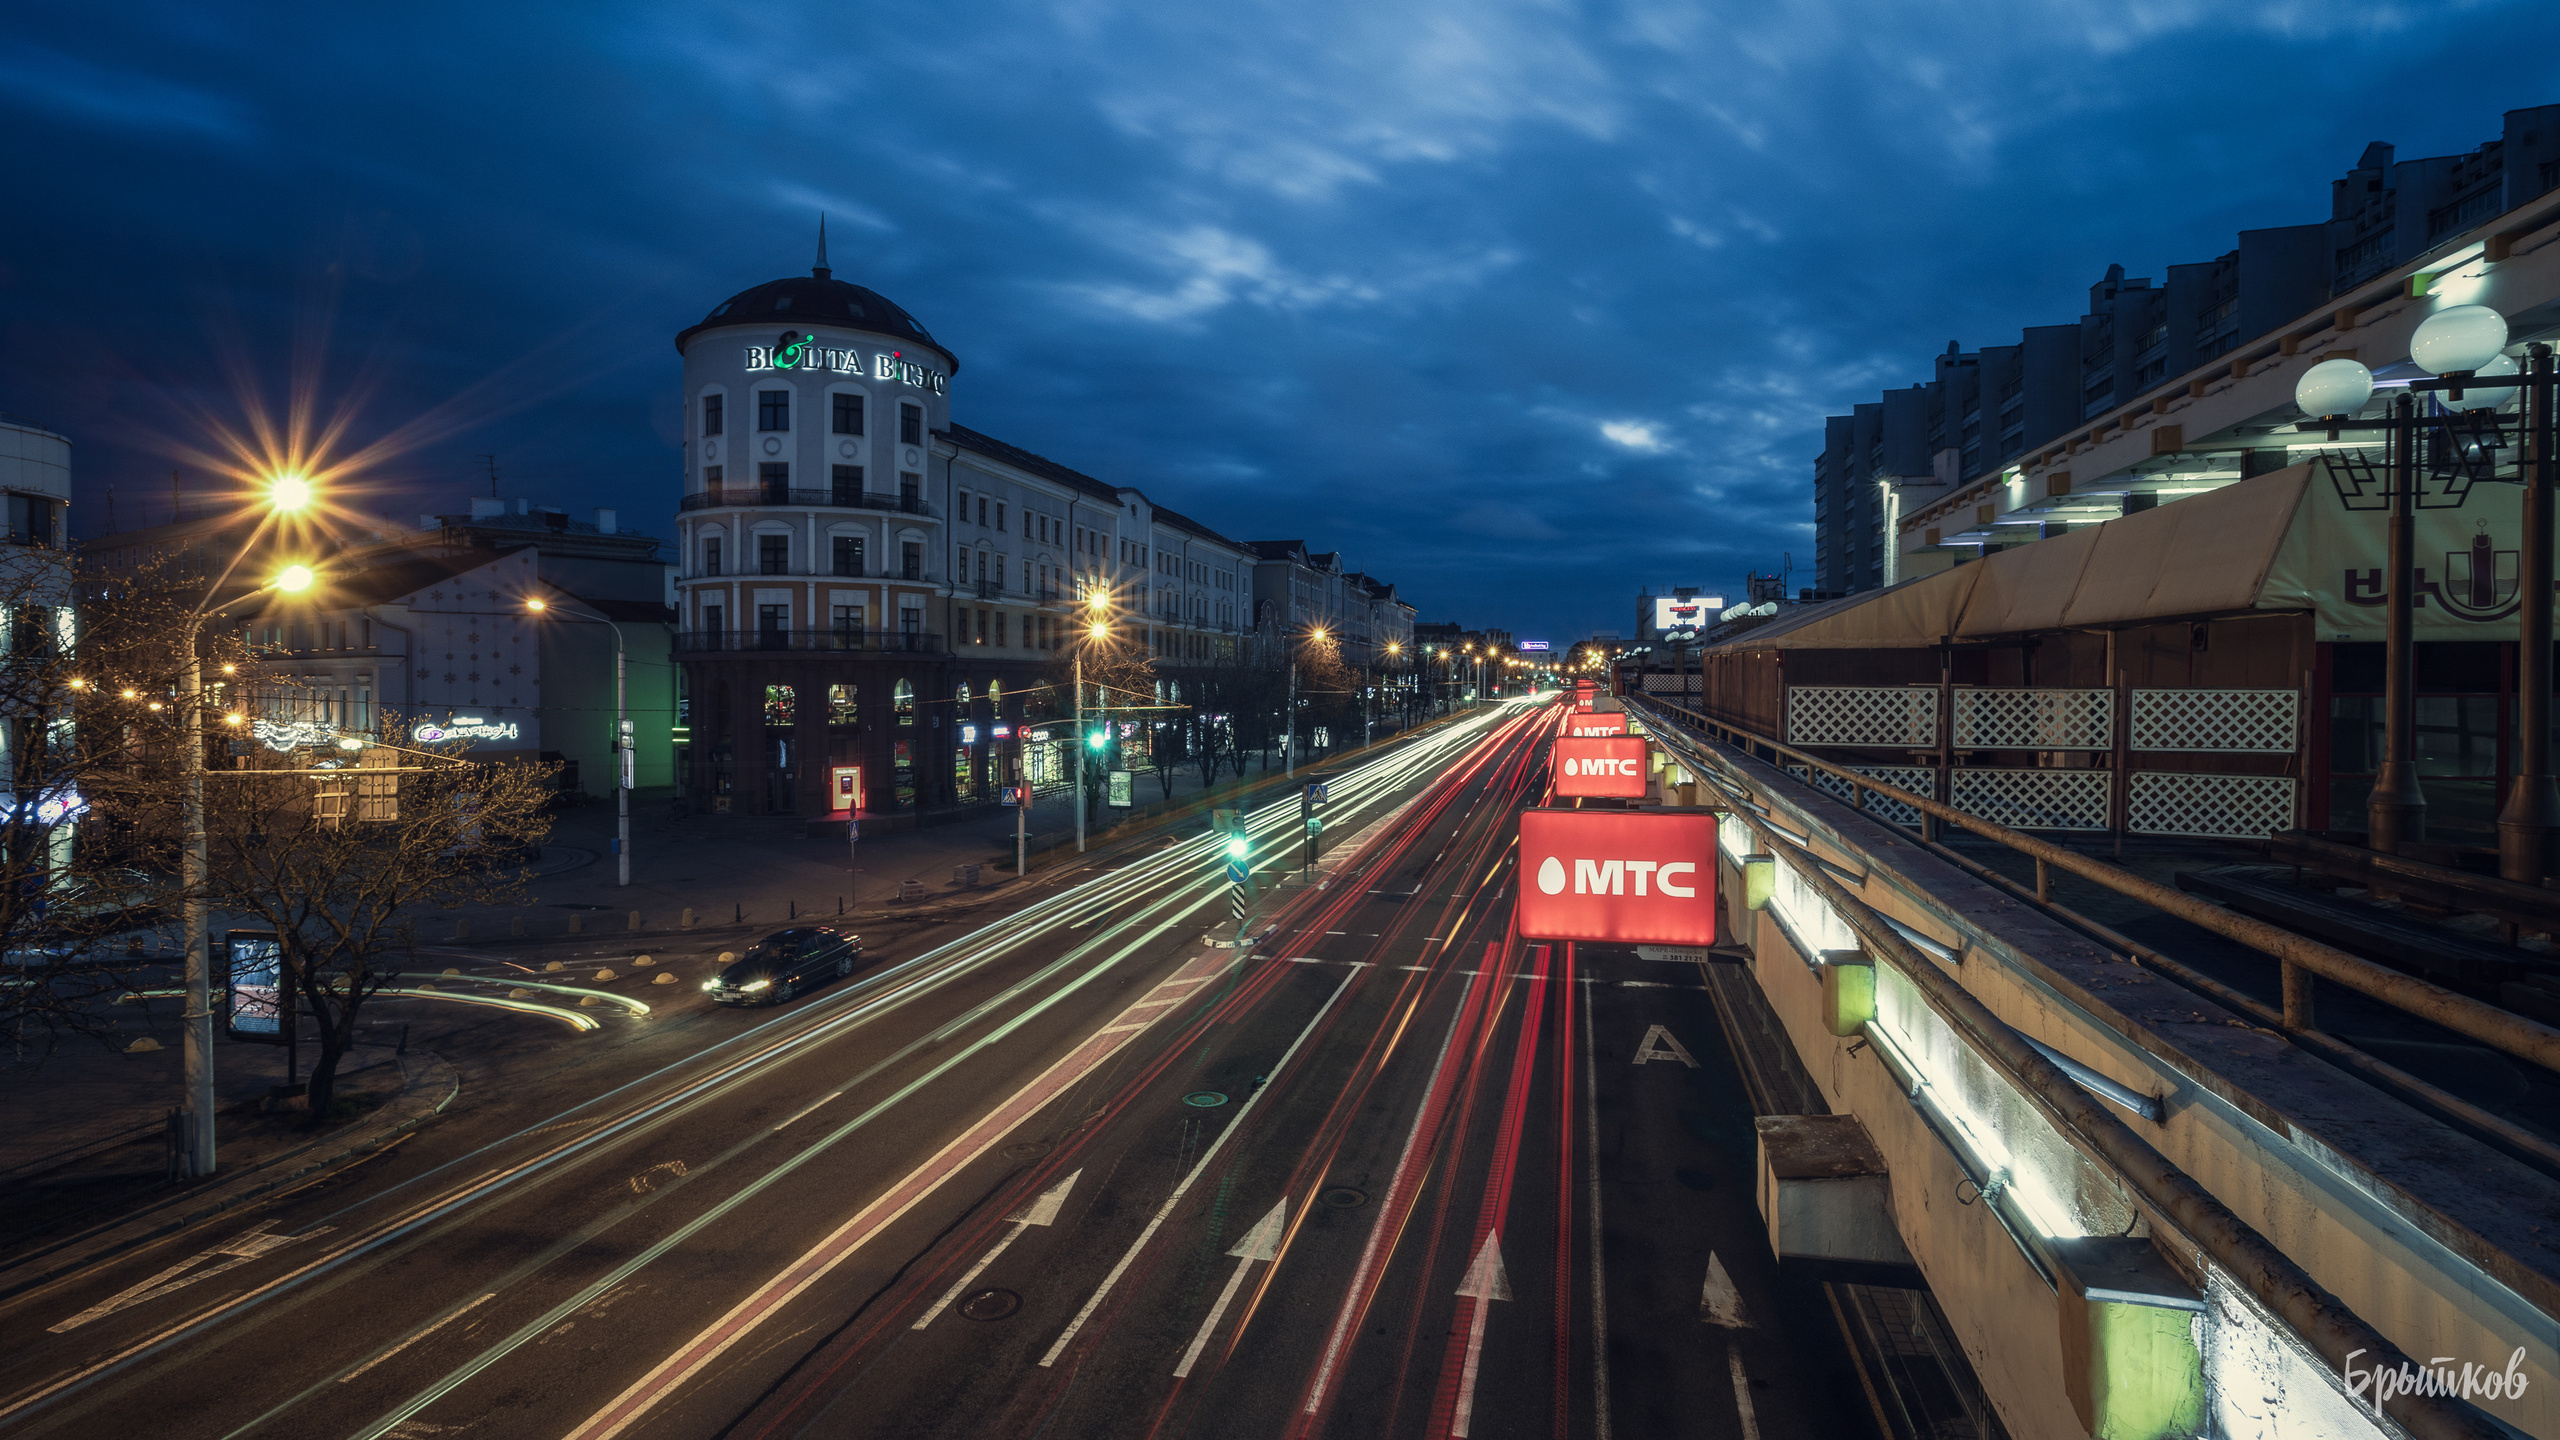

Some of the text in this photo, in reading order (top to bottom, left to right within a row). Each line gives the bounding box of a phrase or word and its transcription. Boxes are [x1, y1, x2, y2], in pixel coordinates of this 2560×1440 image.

[1581, 758, 1637, 776] МТС
[1574, 859, 1696, 898] МТС
[1631, 1024, 1702, 1069] А
